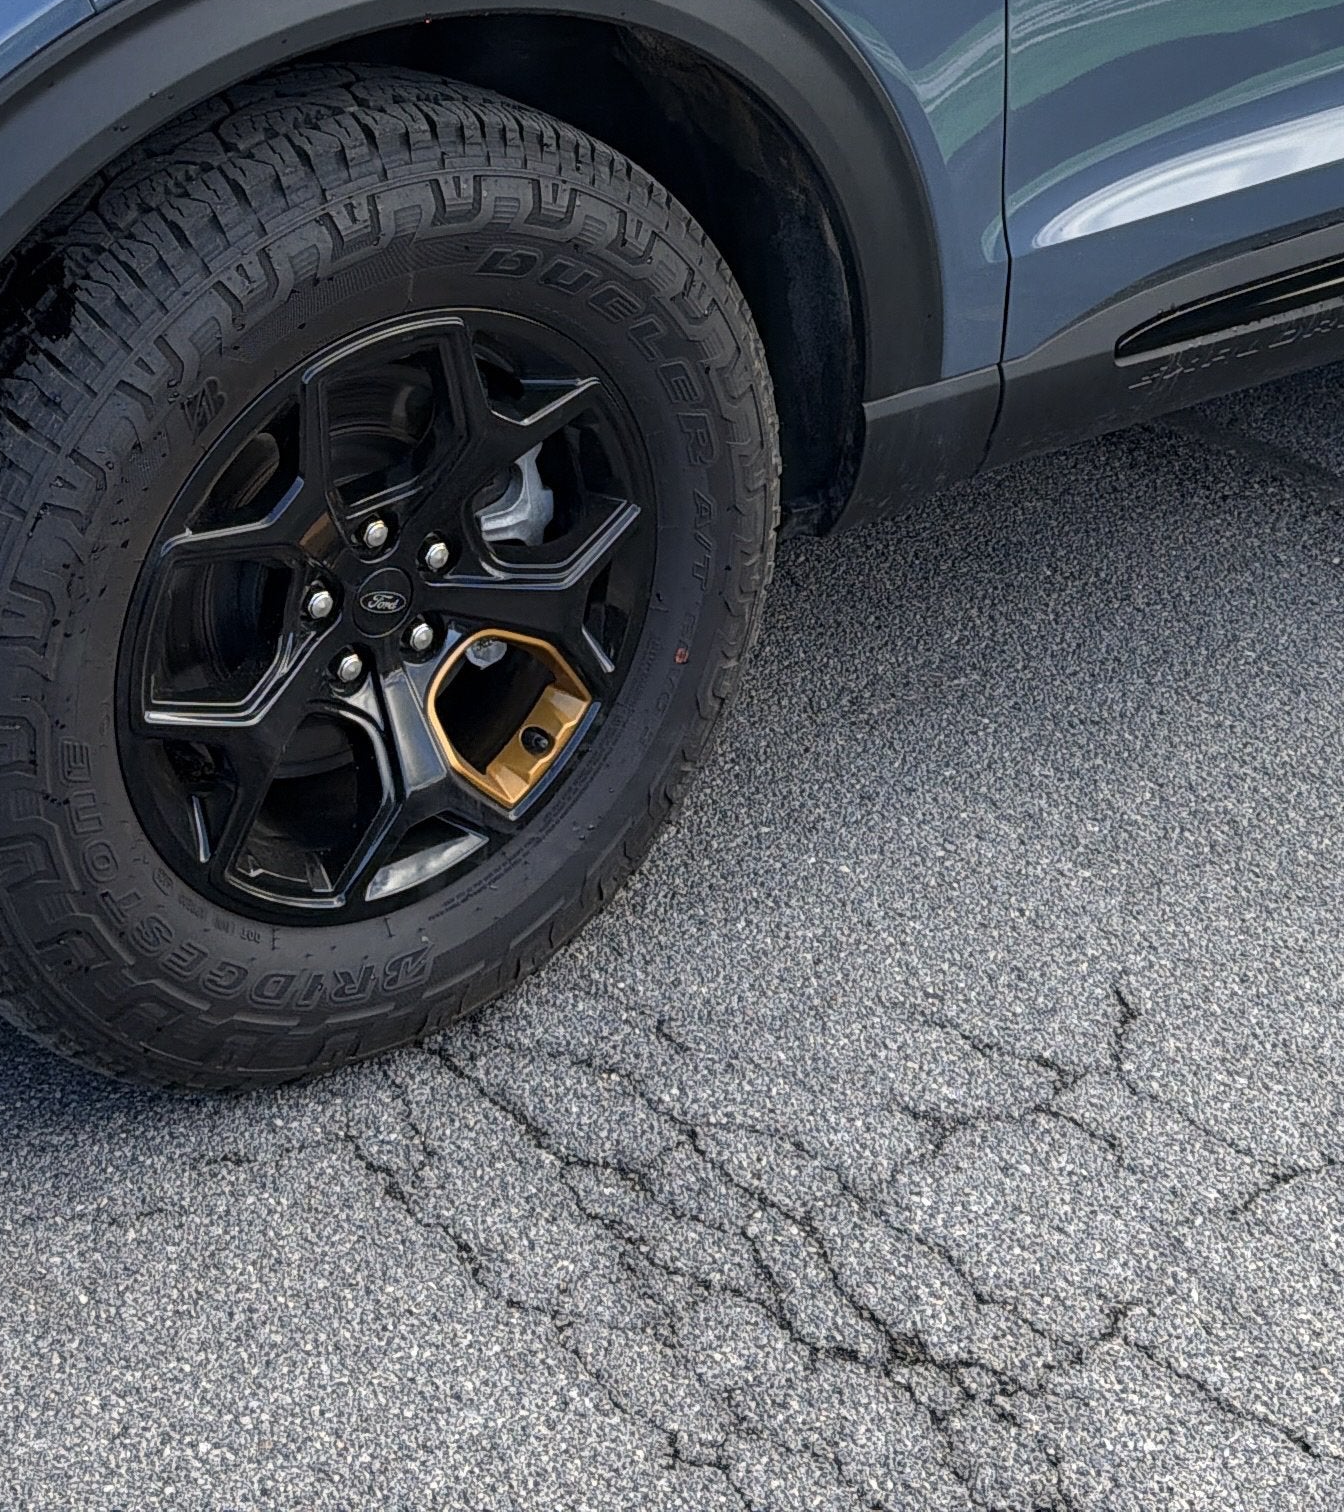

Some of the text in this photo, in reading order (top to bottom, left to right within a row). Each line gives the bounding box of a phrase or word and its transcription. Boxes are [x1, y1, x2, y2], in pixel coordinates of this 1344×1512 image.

[473, 244, 721, 467] DUELER
[365, 592, 402, 610] Ford
[60, 737, 436, 1010] BRIDGESTONE
